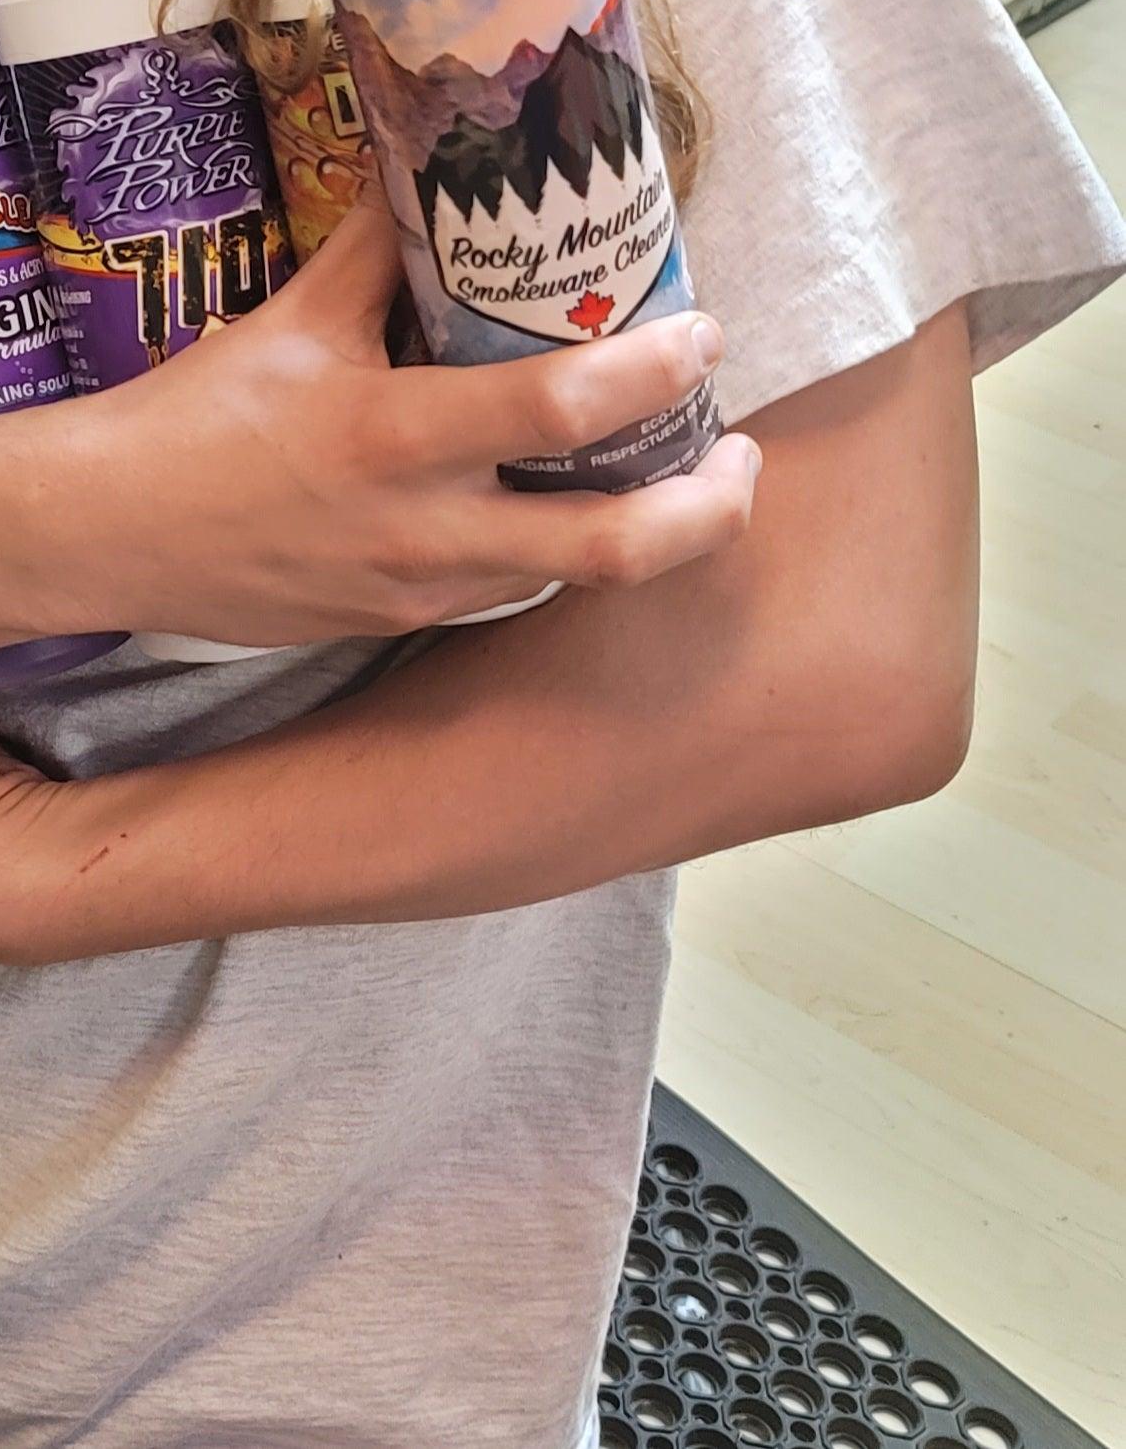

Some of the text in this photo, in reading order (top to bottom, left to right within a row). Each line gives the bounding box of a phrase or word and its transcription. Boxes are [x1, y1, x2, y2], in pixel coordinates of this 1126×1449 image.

[88, 105, 246, 181] PURPLE
[88, 141, 254, 224] POWER
[451, 168, 666, 283] Rocky Mountain
[9, 265, 19, 282] &
[456, 264, 609, 303] Smokeware
[590, 415, 687, 468] RESPECTUEUX
